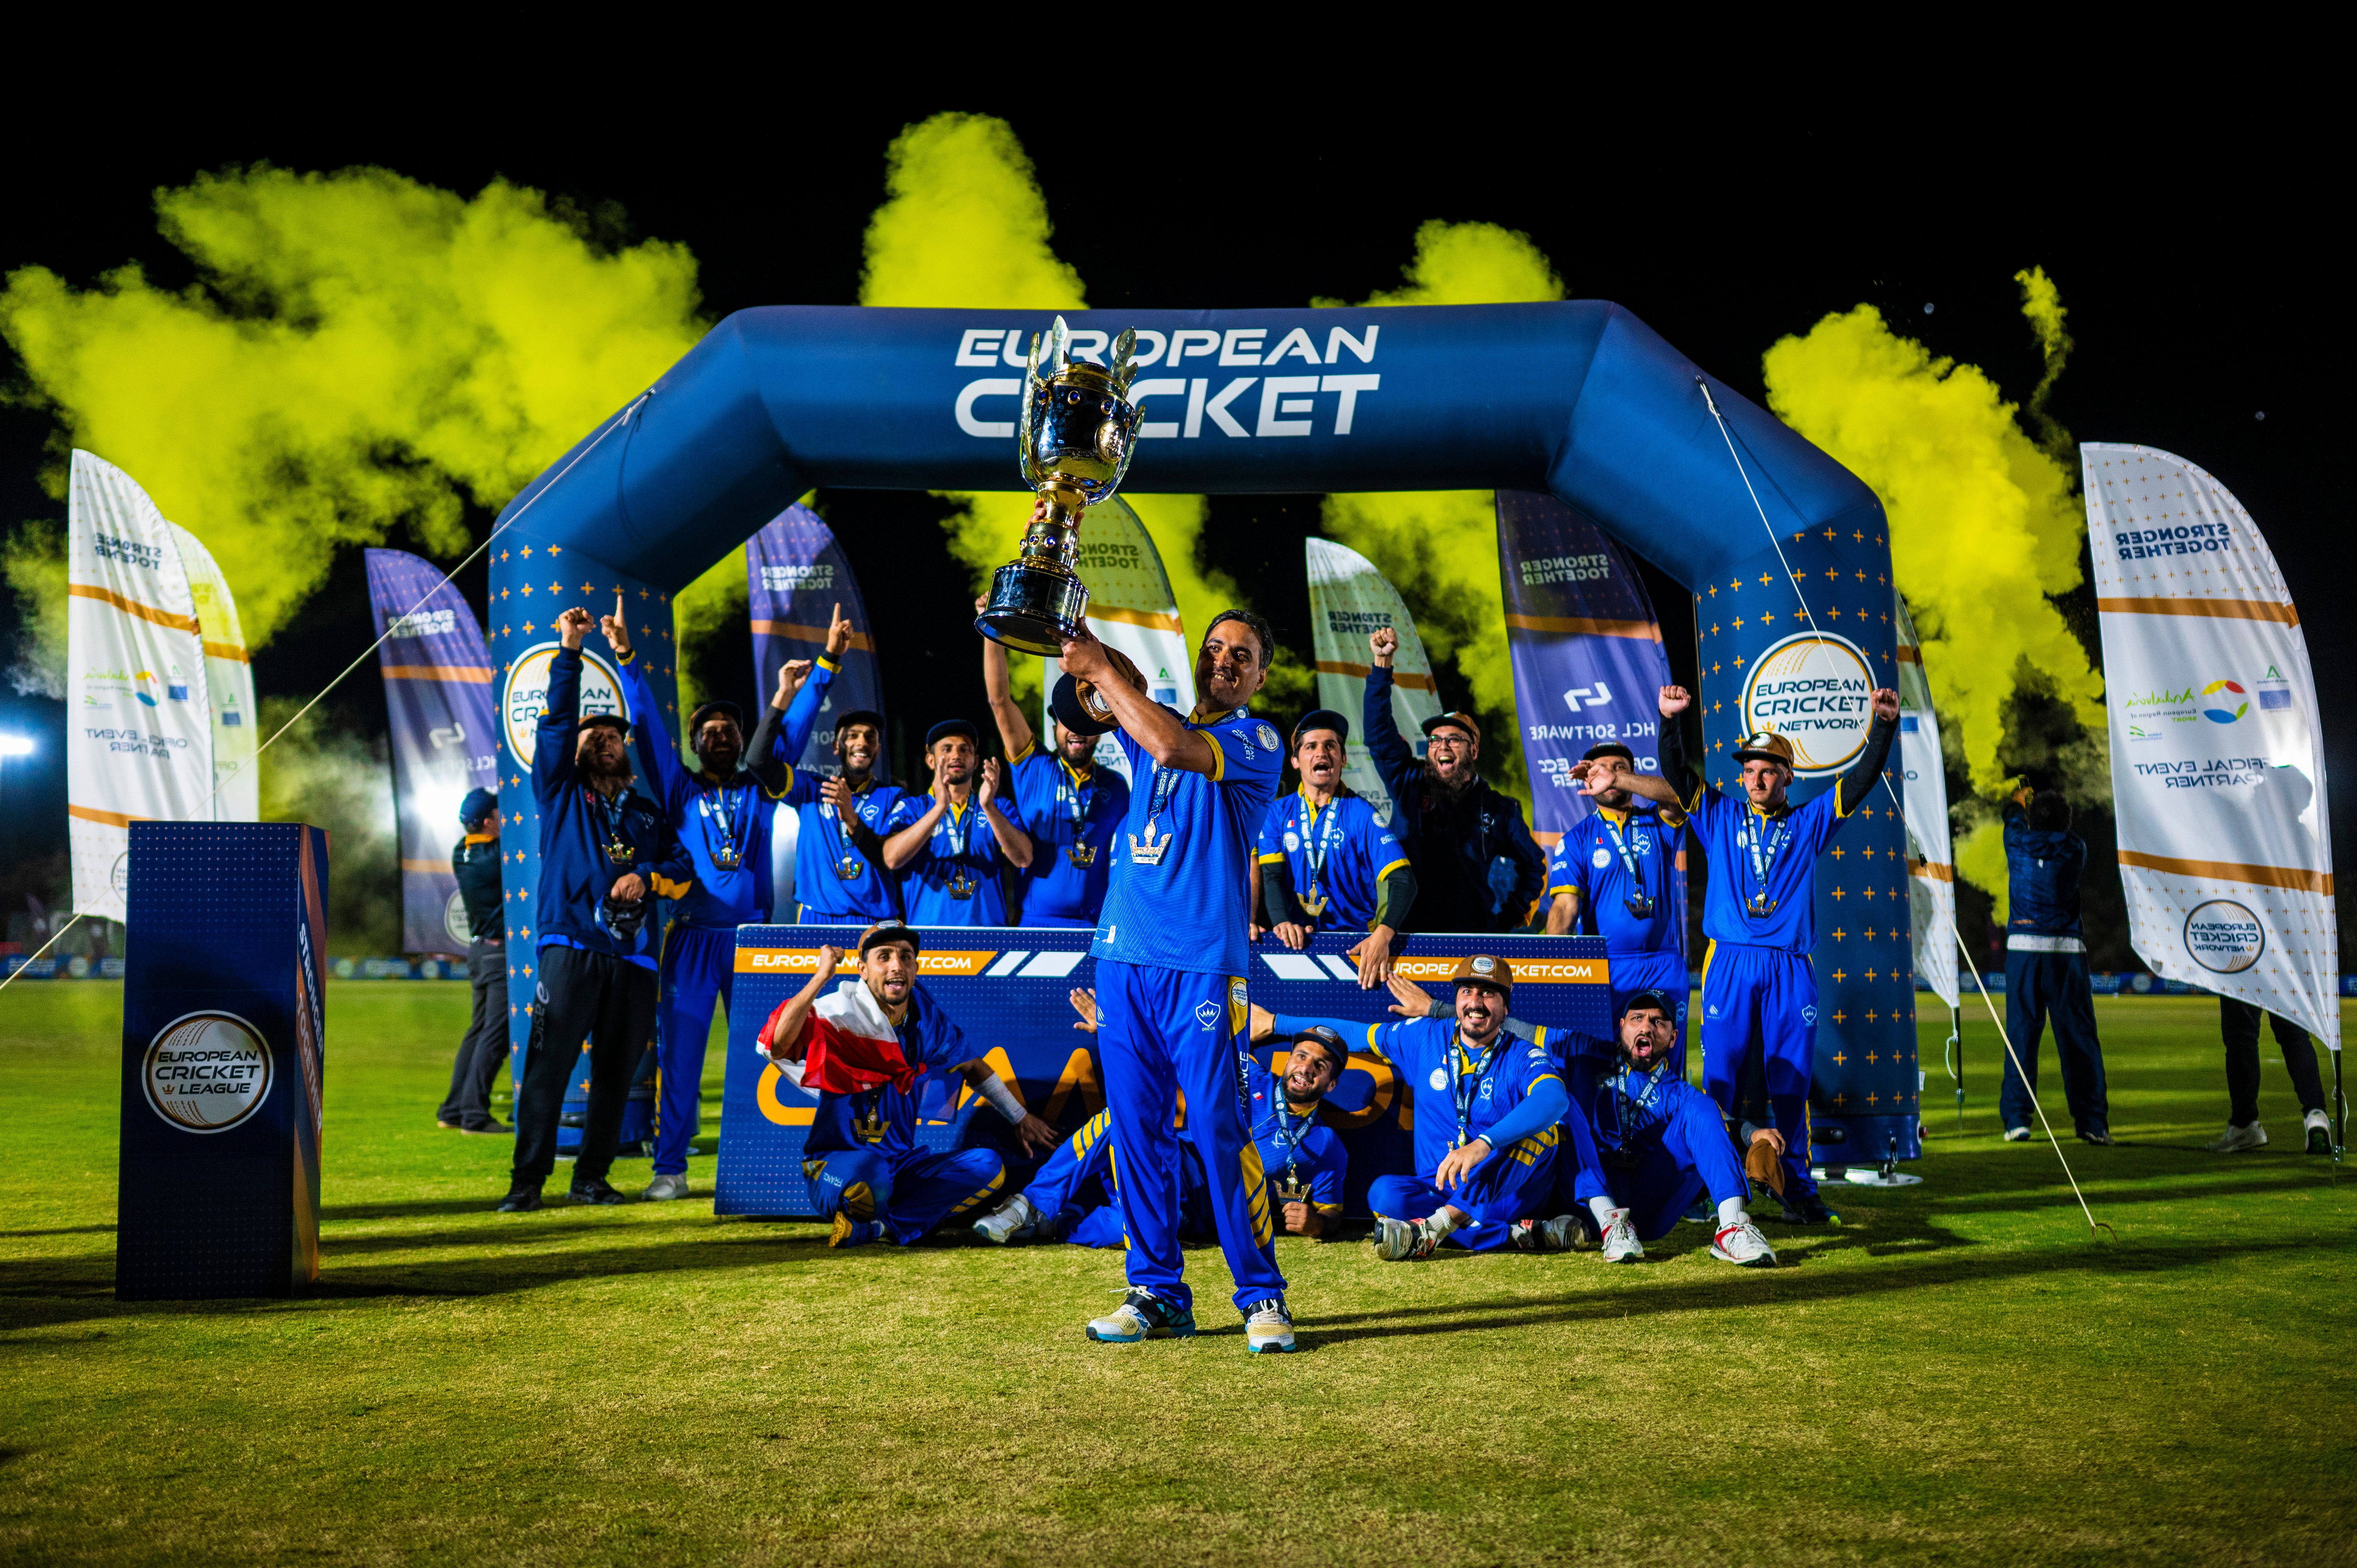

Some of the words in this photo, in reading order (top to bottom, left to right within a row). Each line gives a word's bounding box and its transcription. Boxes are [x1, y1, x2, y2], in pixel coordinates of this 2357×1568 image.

[954, 325, 1379, 367] EUROPEAN
[954, 374, 1380, 438] CCKET
[512, 687, 611, 703] EURAN
[1756, 678, 1866, 697] EUROPEAN
[1754, 696, 1868, 717] CRICKET
[1778, 718, 1865, 732] NETWORK
[1160, 772, 1168, 795] CRICKET
[299, 923, 323, 1058] STRONGER
[158, 1050, 258, 1062] EUROPEAN
[156, 1065, 260, 1080] CRICKET
[1238, 1051, 1249, 1108] RANCE
[178, 1082, 251, 1094] LEAGUE
[1643, 1083, 1654, 1099] CRICKET
